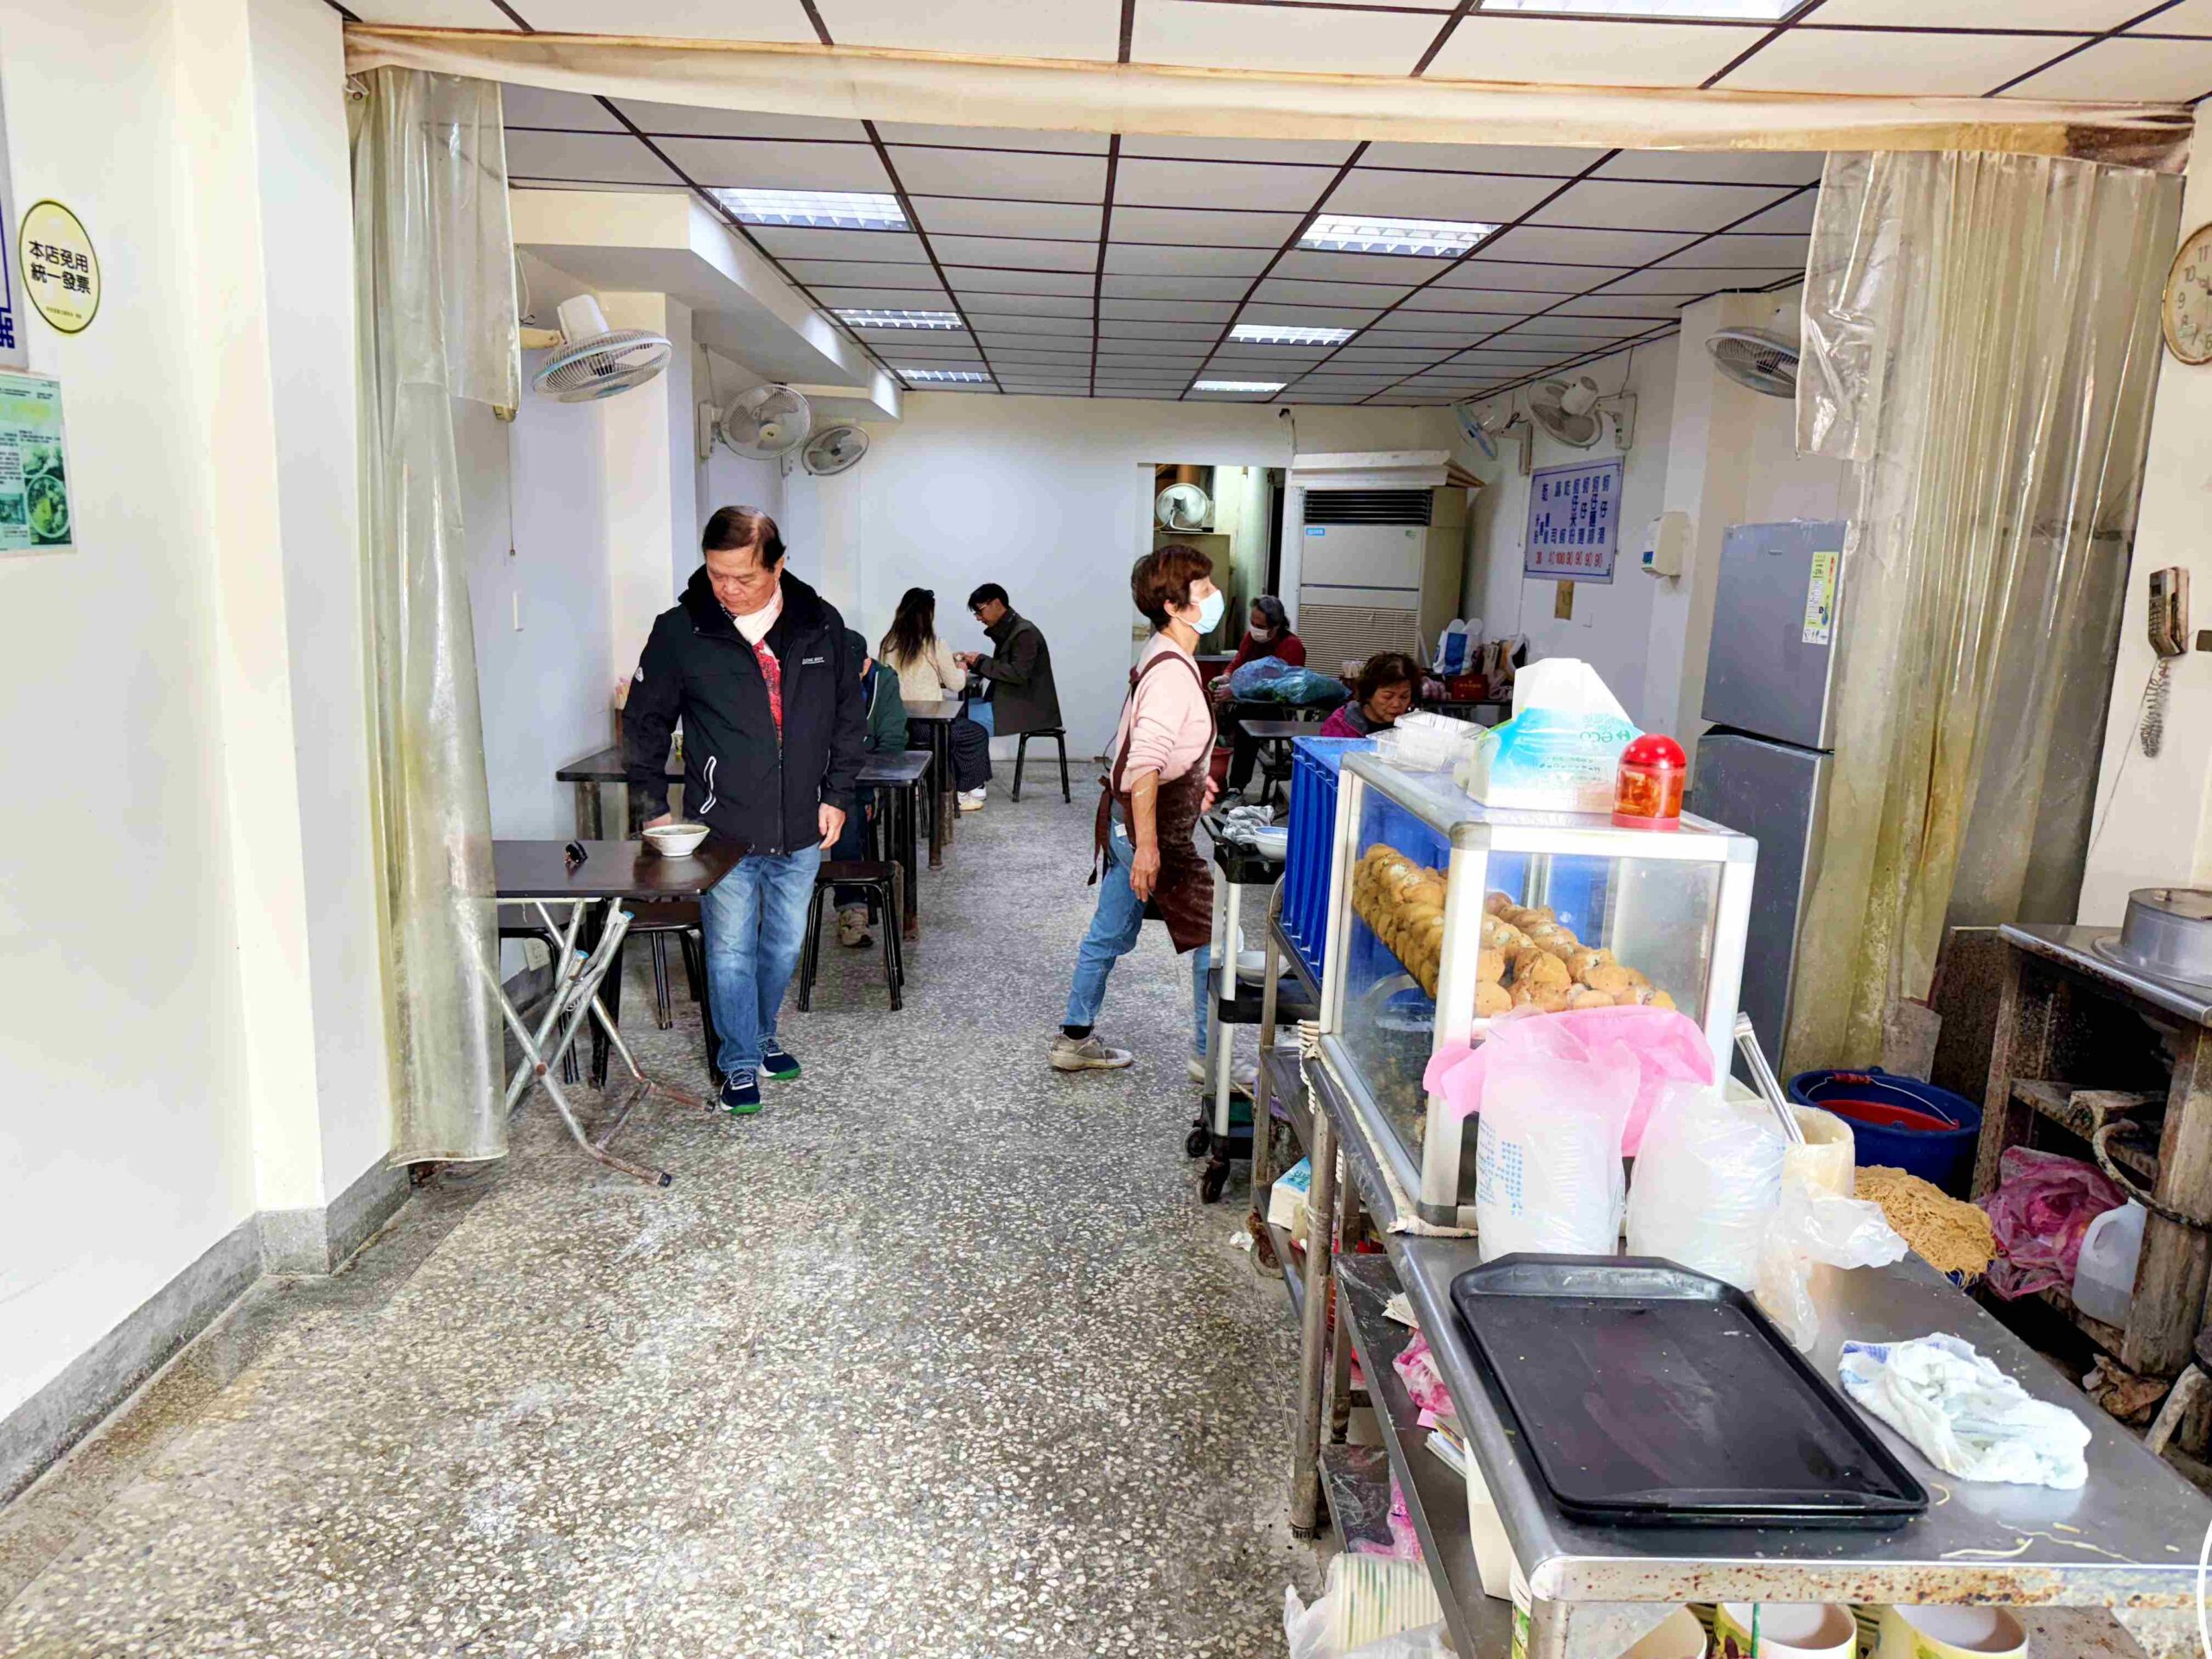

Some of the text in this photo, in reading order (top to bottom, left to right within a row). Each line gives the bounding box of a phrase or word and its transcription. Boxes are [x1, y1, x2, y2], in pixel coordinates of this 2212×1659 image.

[29, 239, 89, 274] 本店免用
[2198, 245, 2211, 263] 11
[30, 263, 92, 295] 統一發票
[2184, 265, 2196, 283] 10
[2178, 292, 2186, 309] 9
[1580, 731, 1613, 744] eco
